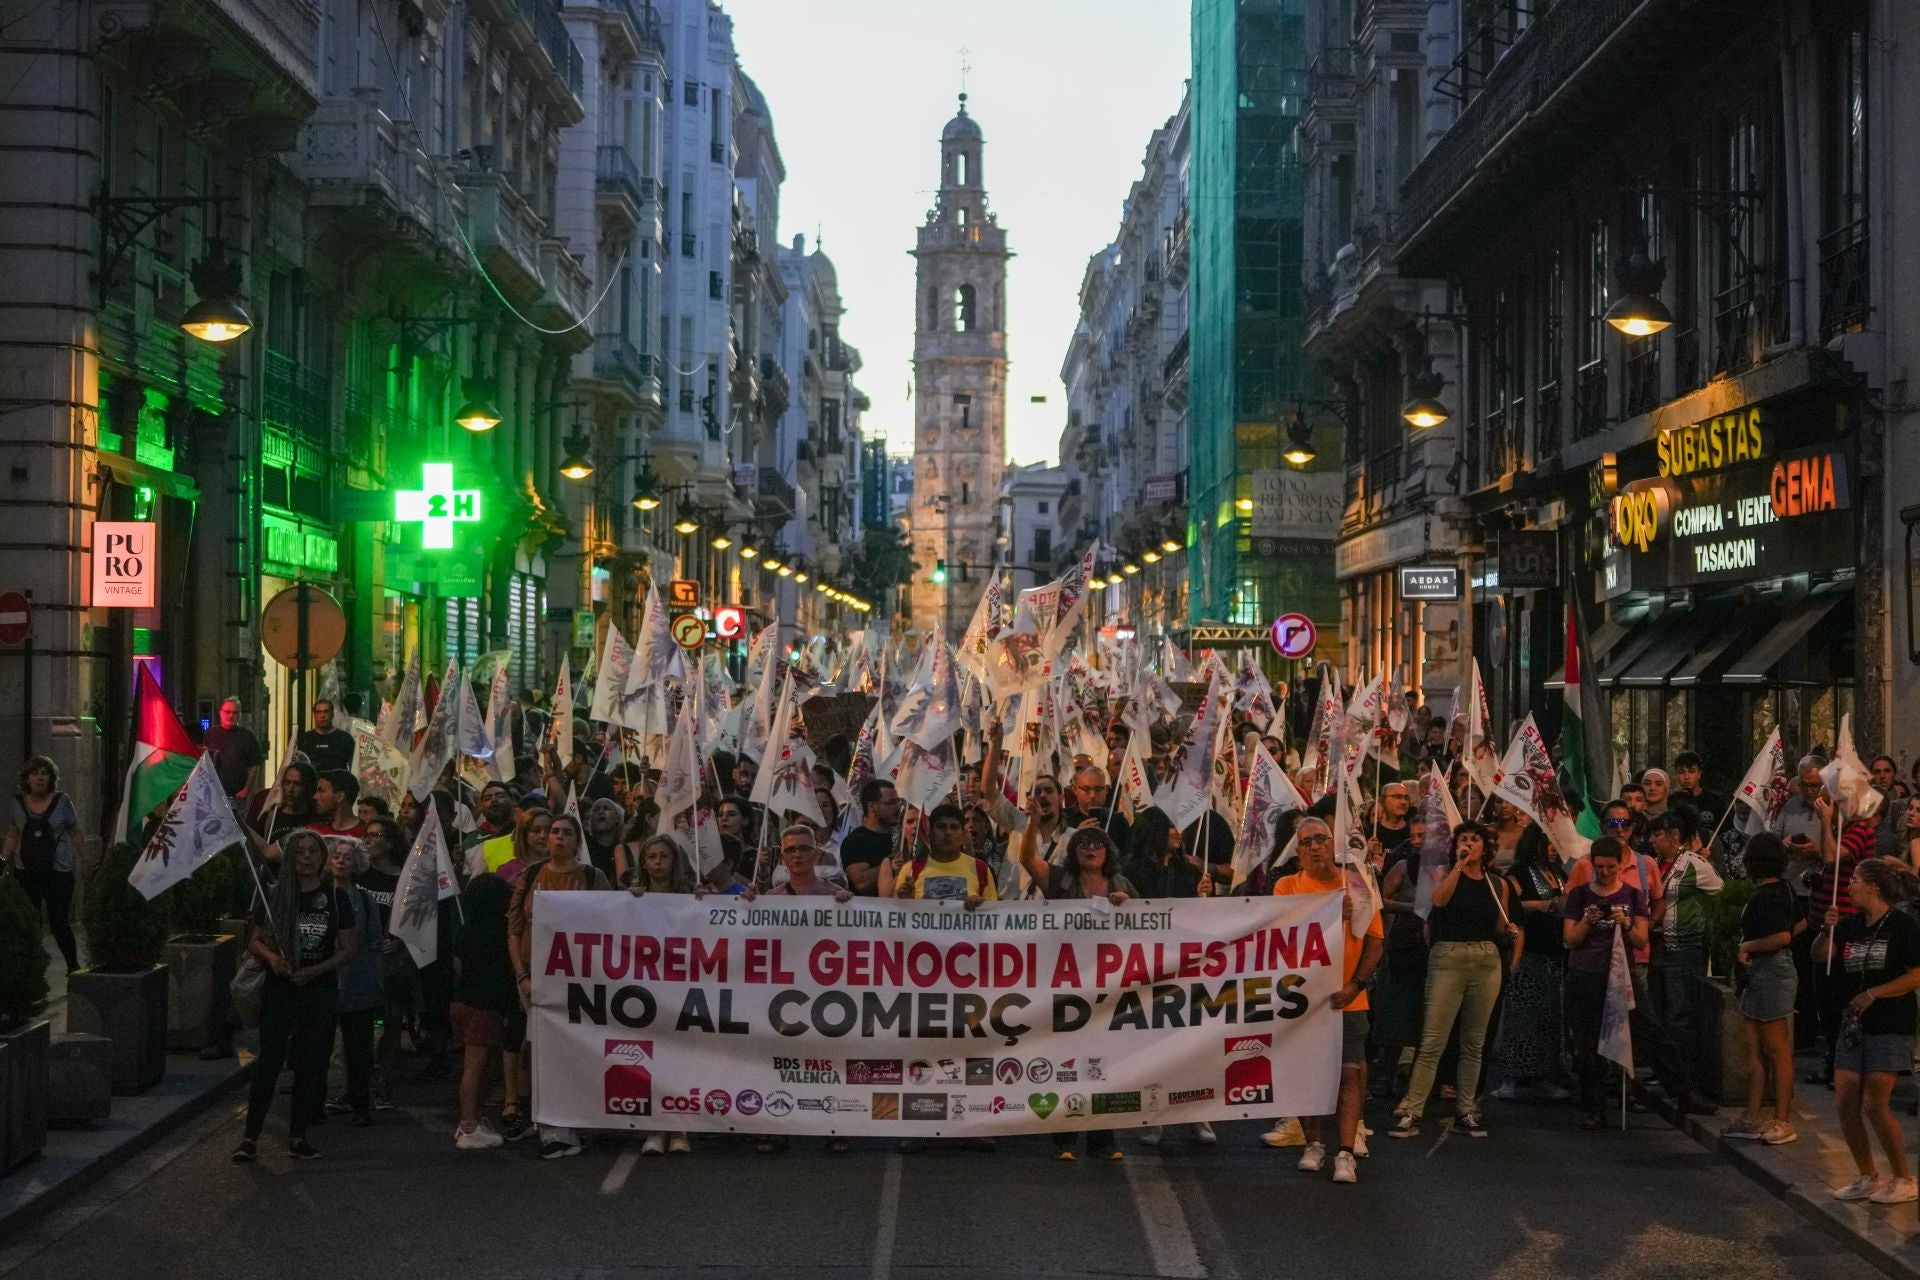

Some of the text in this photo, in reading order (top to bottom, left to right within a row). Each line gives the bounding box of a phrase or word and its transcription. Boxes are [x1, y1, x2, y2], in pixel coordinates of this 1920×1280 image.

[1657, 407, 1762, 478] SUBASTAS
[1264, 477, 1307, 491] TODO
[1771, 453, 1836, 517] GEMA
[1261, 493, 1341, 508] REFORMAS
[1262, 507, 1334, 523] VALENCIA
[1619, 487, 1658, 553] ORO
[1674, 503, 1724, 537] COMPRA
[106, 533, 144, 555] PU
[1695, 538, 1756, 573] TASACION
[105, 556, 143, 578] RO
[104, 586, 143, 595] VINTAGE
[1410, 576, 1449, 584] AEDAS
[709, 908, 1174, 931] 27S JORNADA DE LLUITA EN SOLIDARITAT AMB EL POBLE PALESTÍ
[544, 922, 1332, 988] ATUREM EL GENOCIDI A PALESTINA
[567, 973, 1310, 1046] NO AL COMERÇ D'ARMES
[772, 1056, 800, 1070] BDS
[779, 1069, 841, 1085] VALENCIÀ
[1228, 1084, 1270, 1103] CGT
[608, 1097, 649, 1113] CGT
